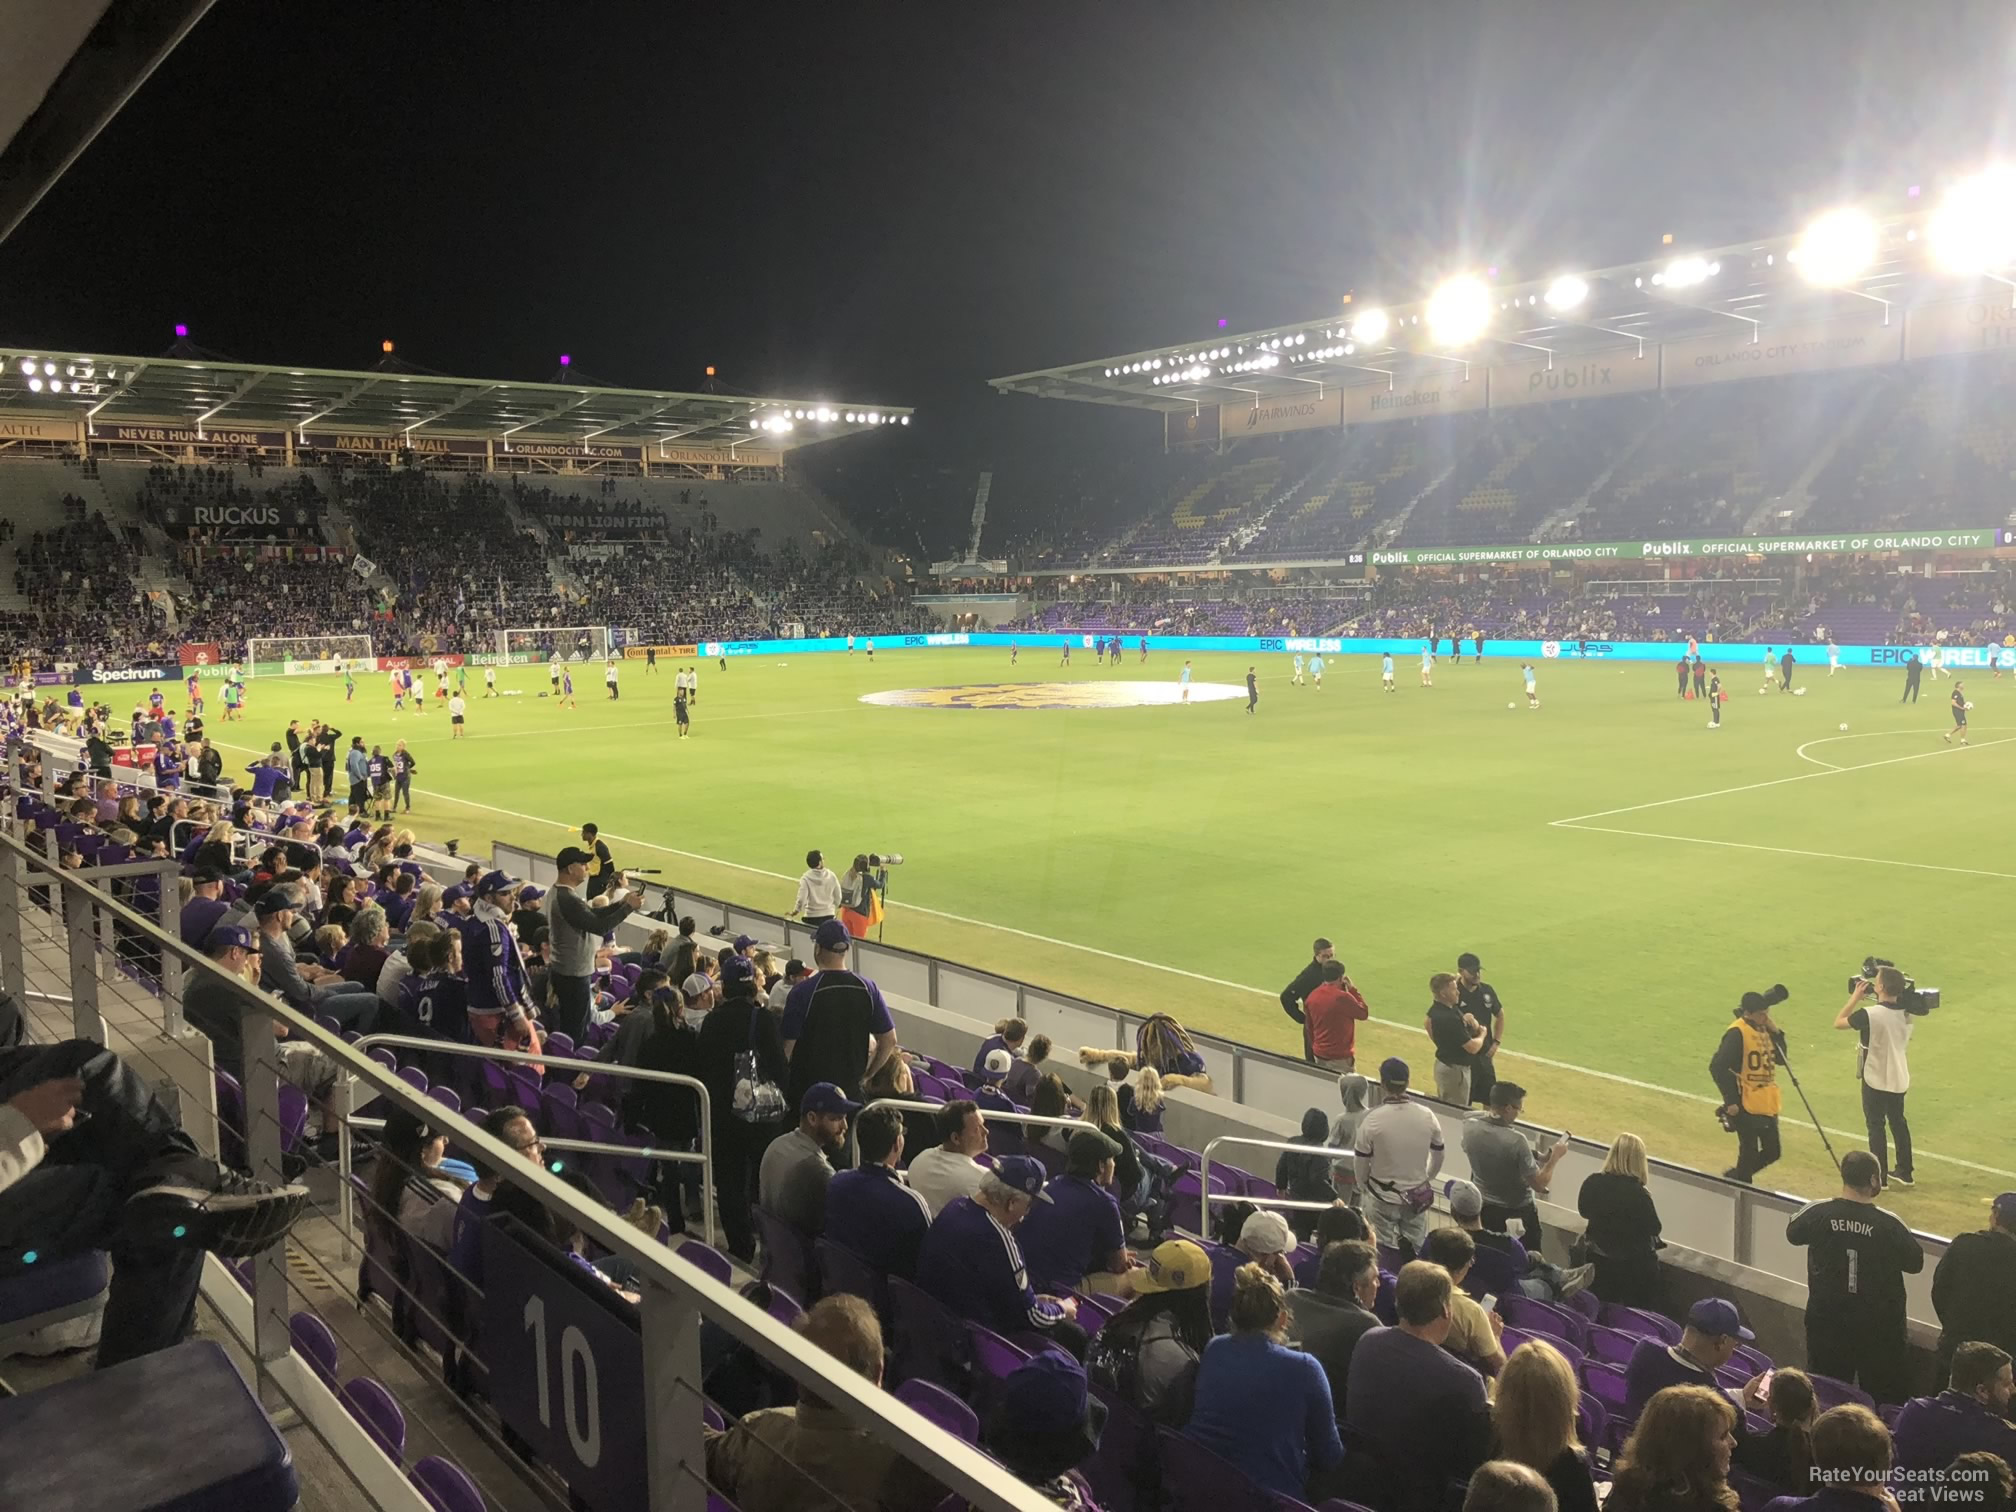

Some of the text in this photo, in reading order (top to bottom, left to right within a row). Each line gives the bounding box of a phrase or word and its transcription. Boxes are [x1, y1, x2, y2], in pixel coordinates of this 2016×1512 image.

[1694, 336, 1866, 368] ORLANDO CITY STADIUM
[1529, 364, 1612, 392] Publix
[1370, 391, 1440, 411] Heineken
[1258, 403, 1316, 420] FAIRWINDS
[119, 428, 165, 439] NEVER
[212, 432, 258, 444] ALONE
[336, 436, 451, 452] MAN THE WALL
[516, 445, 622, 457] ORLANDOCITYC.COM
[670, 450, 721, 462] ORLANDO
[194, 507, 280, 525] RUCKUS
[545, 514, 665, 528] IRON LION FIRM
[1702, 542, 1754, 553] OFFICIAL
[1758, 540, 1847, 552] SUPERMARKET
[1851, 539, 1870, 549] OF
[1873, 537, 1943, 549] ORLANDO
[1947, 535, 1981, 546] CITY
[1417, 552, 1456, 562] OFFICIAL
[1458, 550, 1523, 561] SUPERMARKET
[1526, 549, 1540, 559] OF
[1542, 548, 1592, 558] ORLANDO
[1594, 547, 1619, 557] CITY
[905, 636, 925, 646] EPIC
[1260, 638, 1341, 652] EPIC WIRELESS
[471, 653, 528, 665] Heineken
[627, 647, 671, 658] Contintal
[1871, 648, 1913, 664] EPIC
[92, 668, 161, 683] Spectrum
[1830, 1219, 1874, 1237] BENDIK
[1846, 1249, 1858, 1293] 1
[524, 1294, 600, 1467] 10
